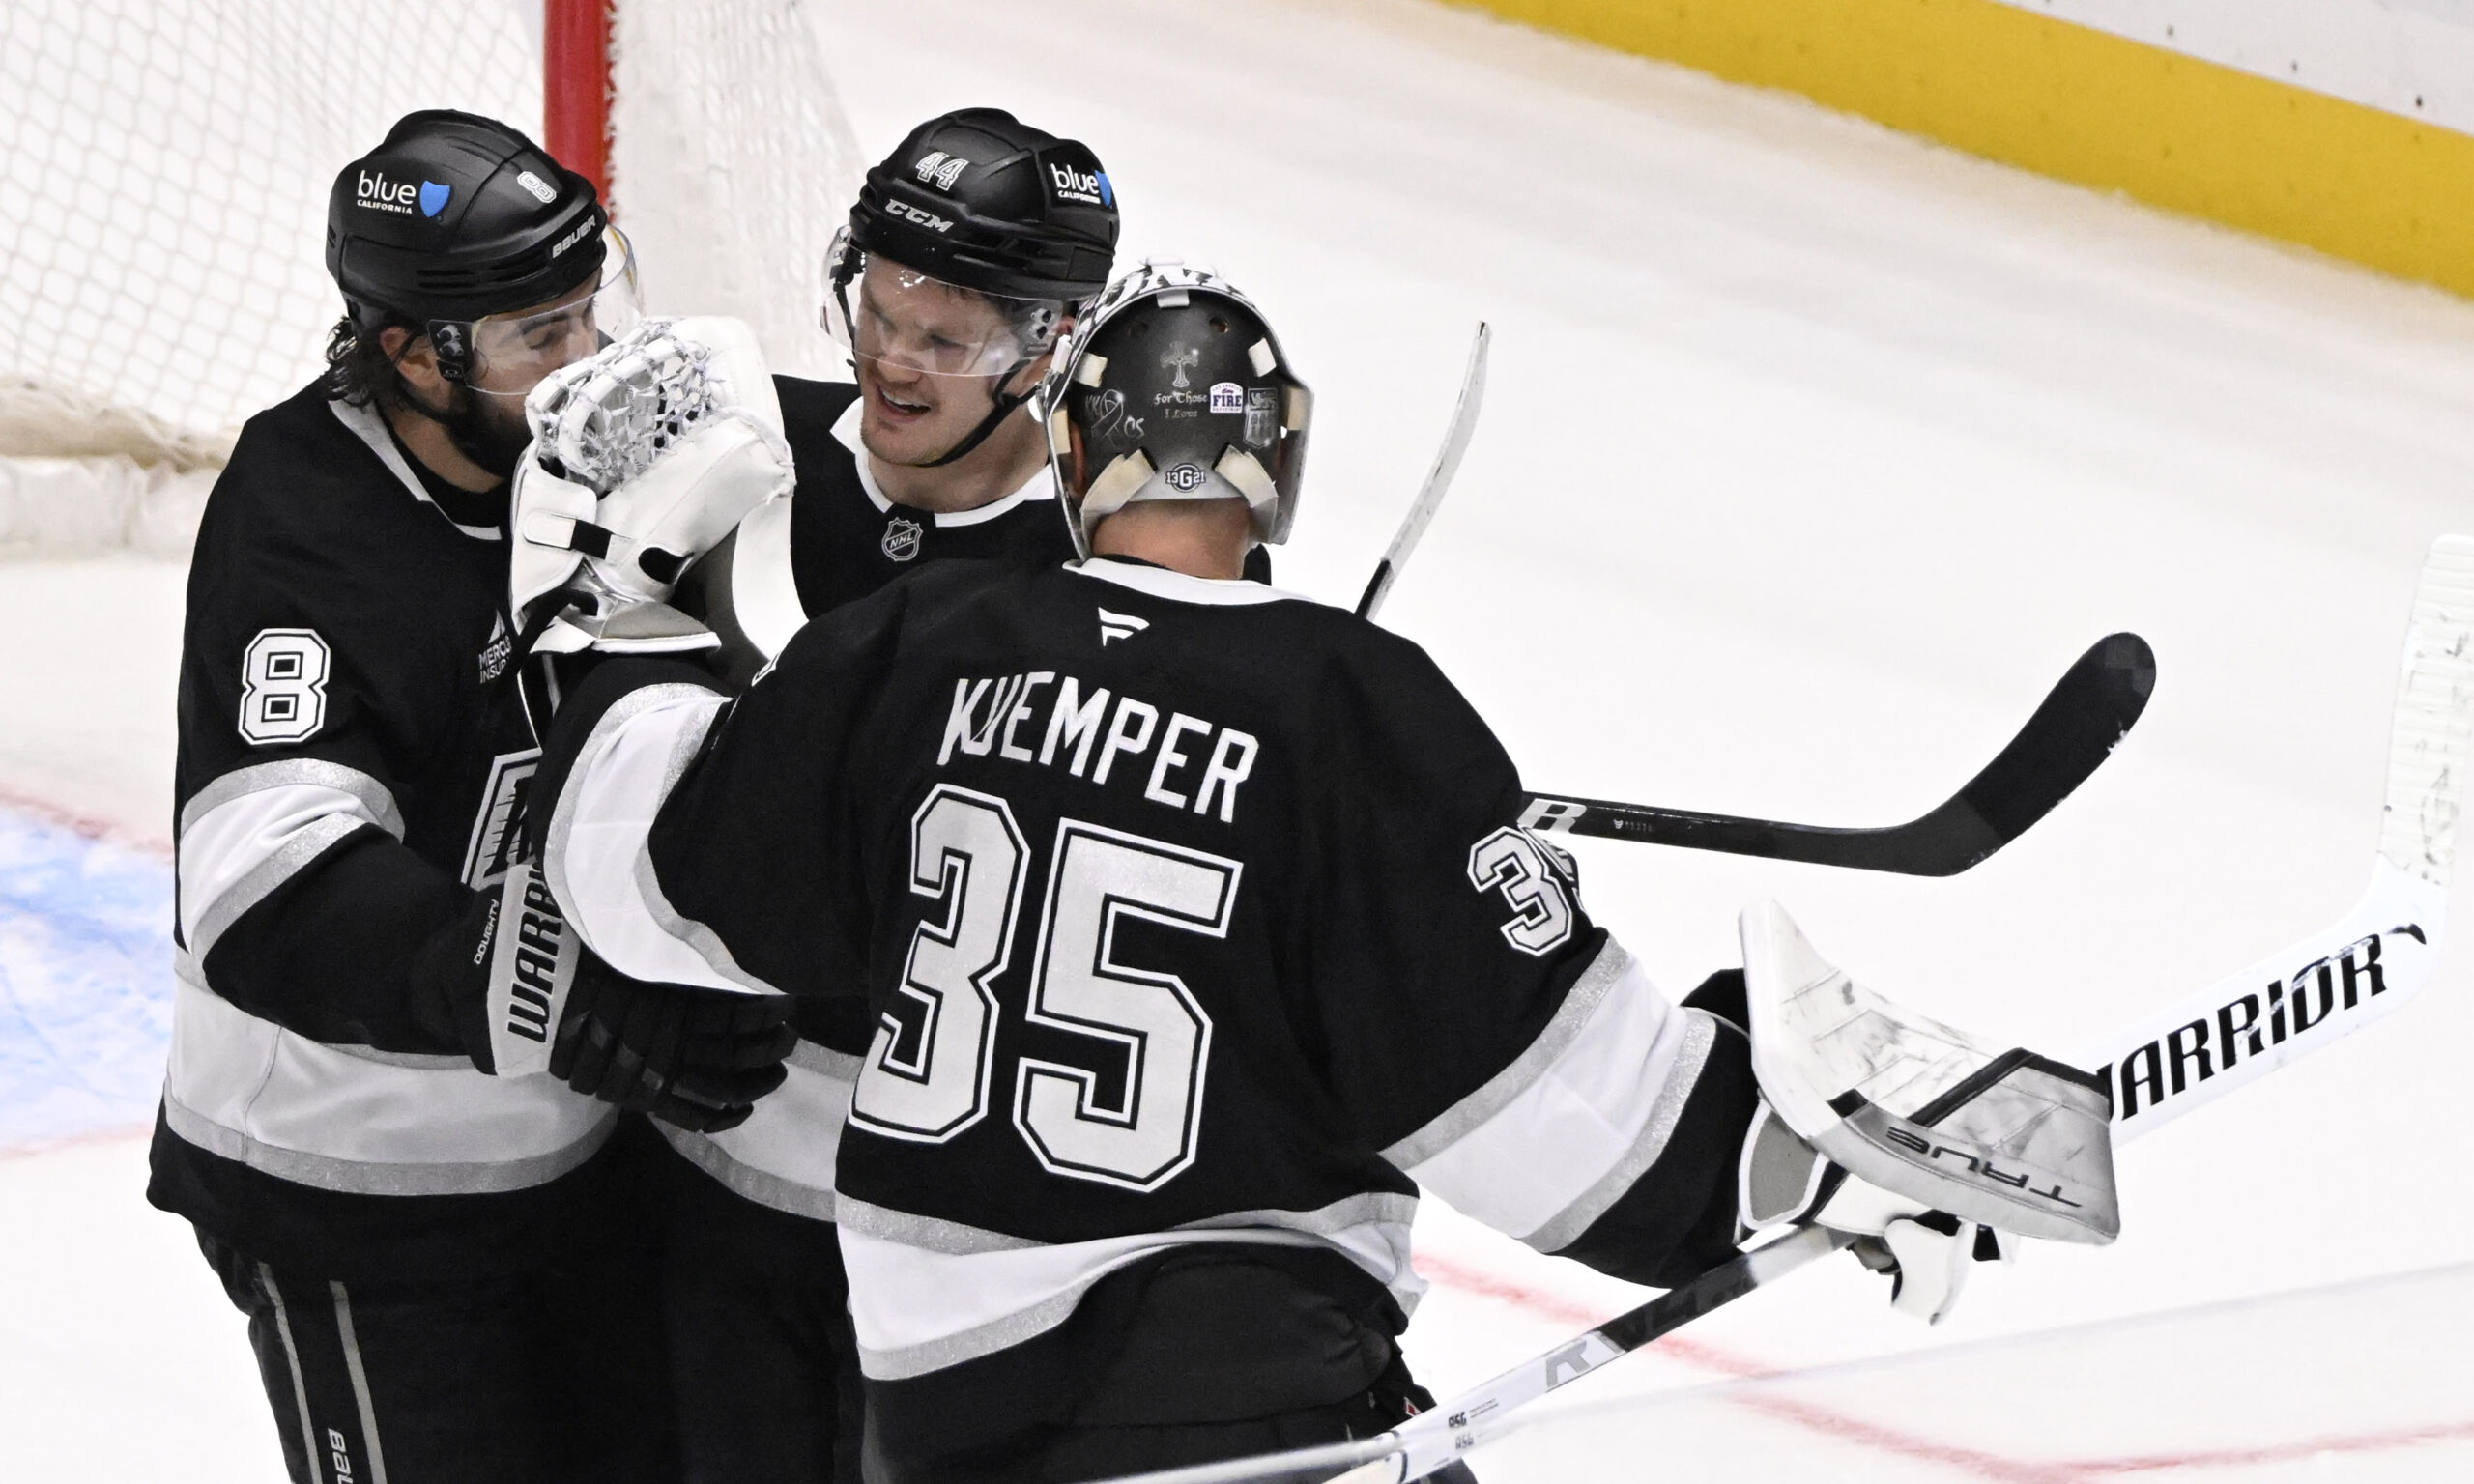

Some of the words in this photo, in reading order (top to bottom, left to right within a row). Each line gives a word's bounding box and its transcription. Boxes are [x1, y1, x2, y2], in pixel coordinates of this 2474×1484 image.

[357, 170, 417, 205] blue
[516, 170, 557, 204] 8
[915, 151, 969, 192] 44
[1050, 163, 1100, 194] blue
[357, 198, 413, 214] CALIFORNIA
[885, 198, 955, 233] CCM
[552, 214, 597, 259] BAUER
[1171, 390, 1208, 405] Those
[1212, 394, 1243, 407] FIRE
[889, 532, 914, 550] NHL
[478, 635, 512, 670] MERCU
[238, 627, 331, 745] 8
[936, 671, 1260, 823] KUEMPER
[1466, 825, 1579, 956] 3
[473, 898, 501, 967] DOUGHTY
[506, 863, 564, 1043] WARR
[847, 783, 1245, 1194] 35
[1884, 1125, 2083, 1208] TRUE
